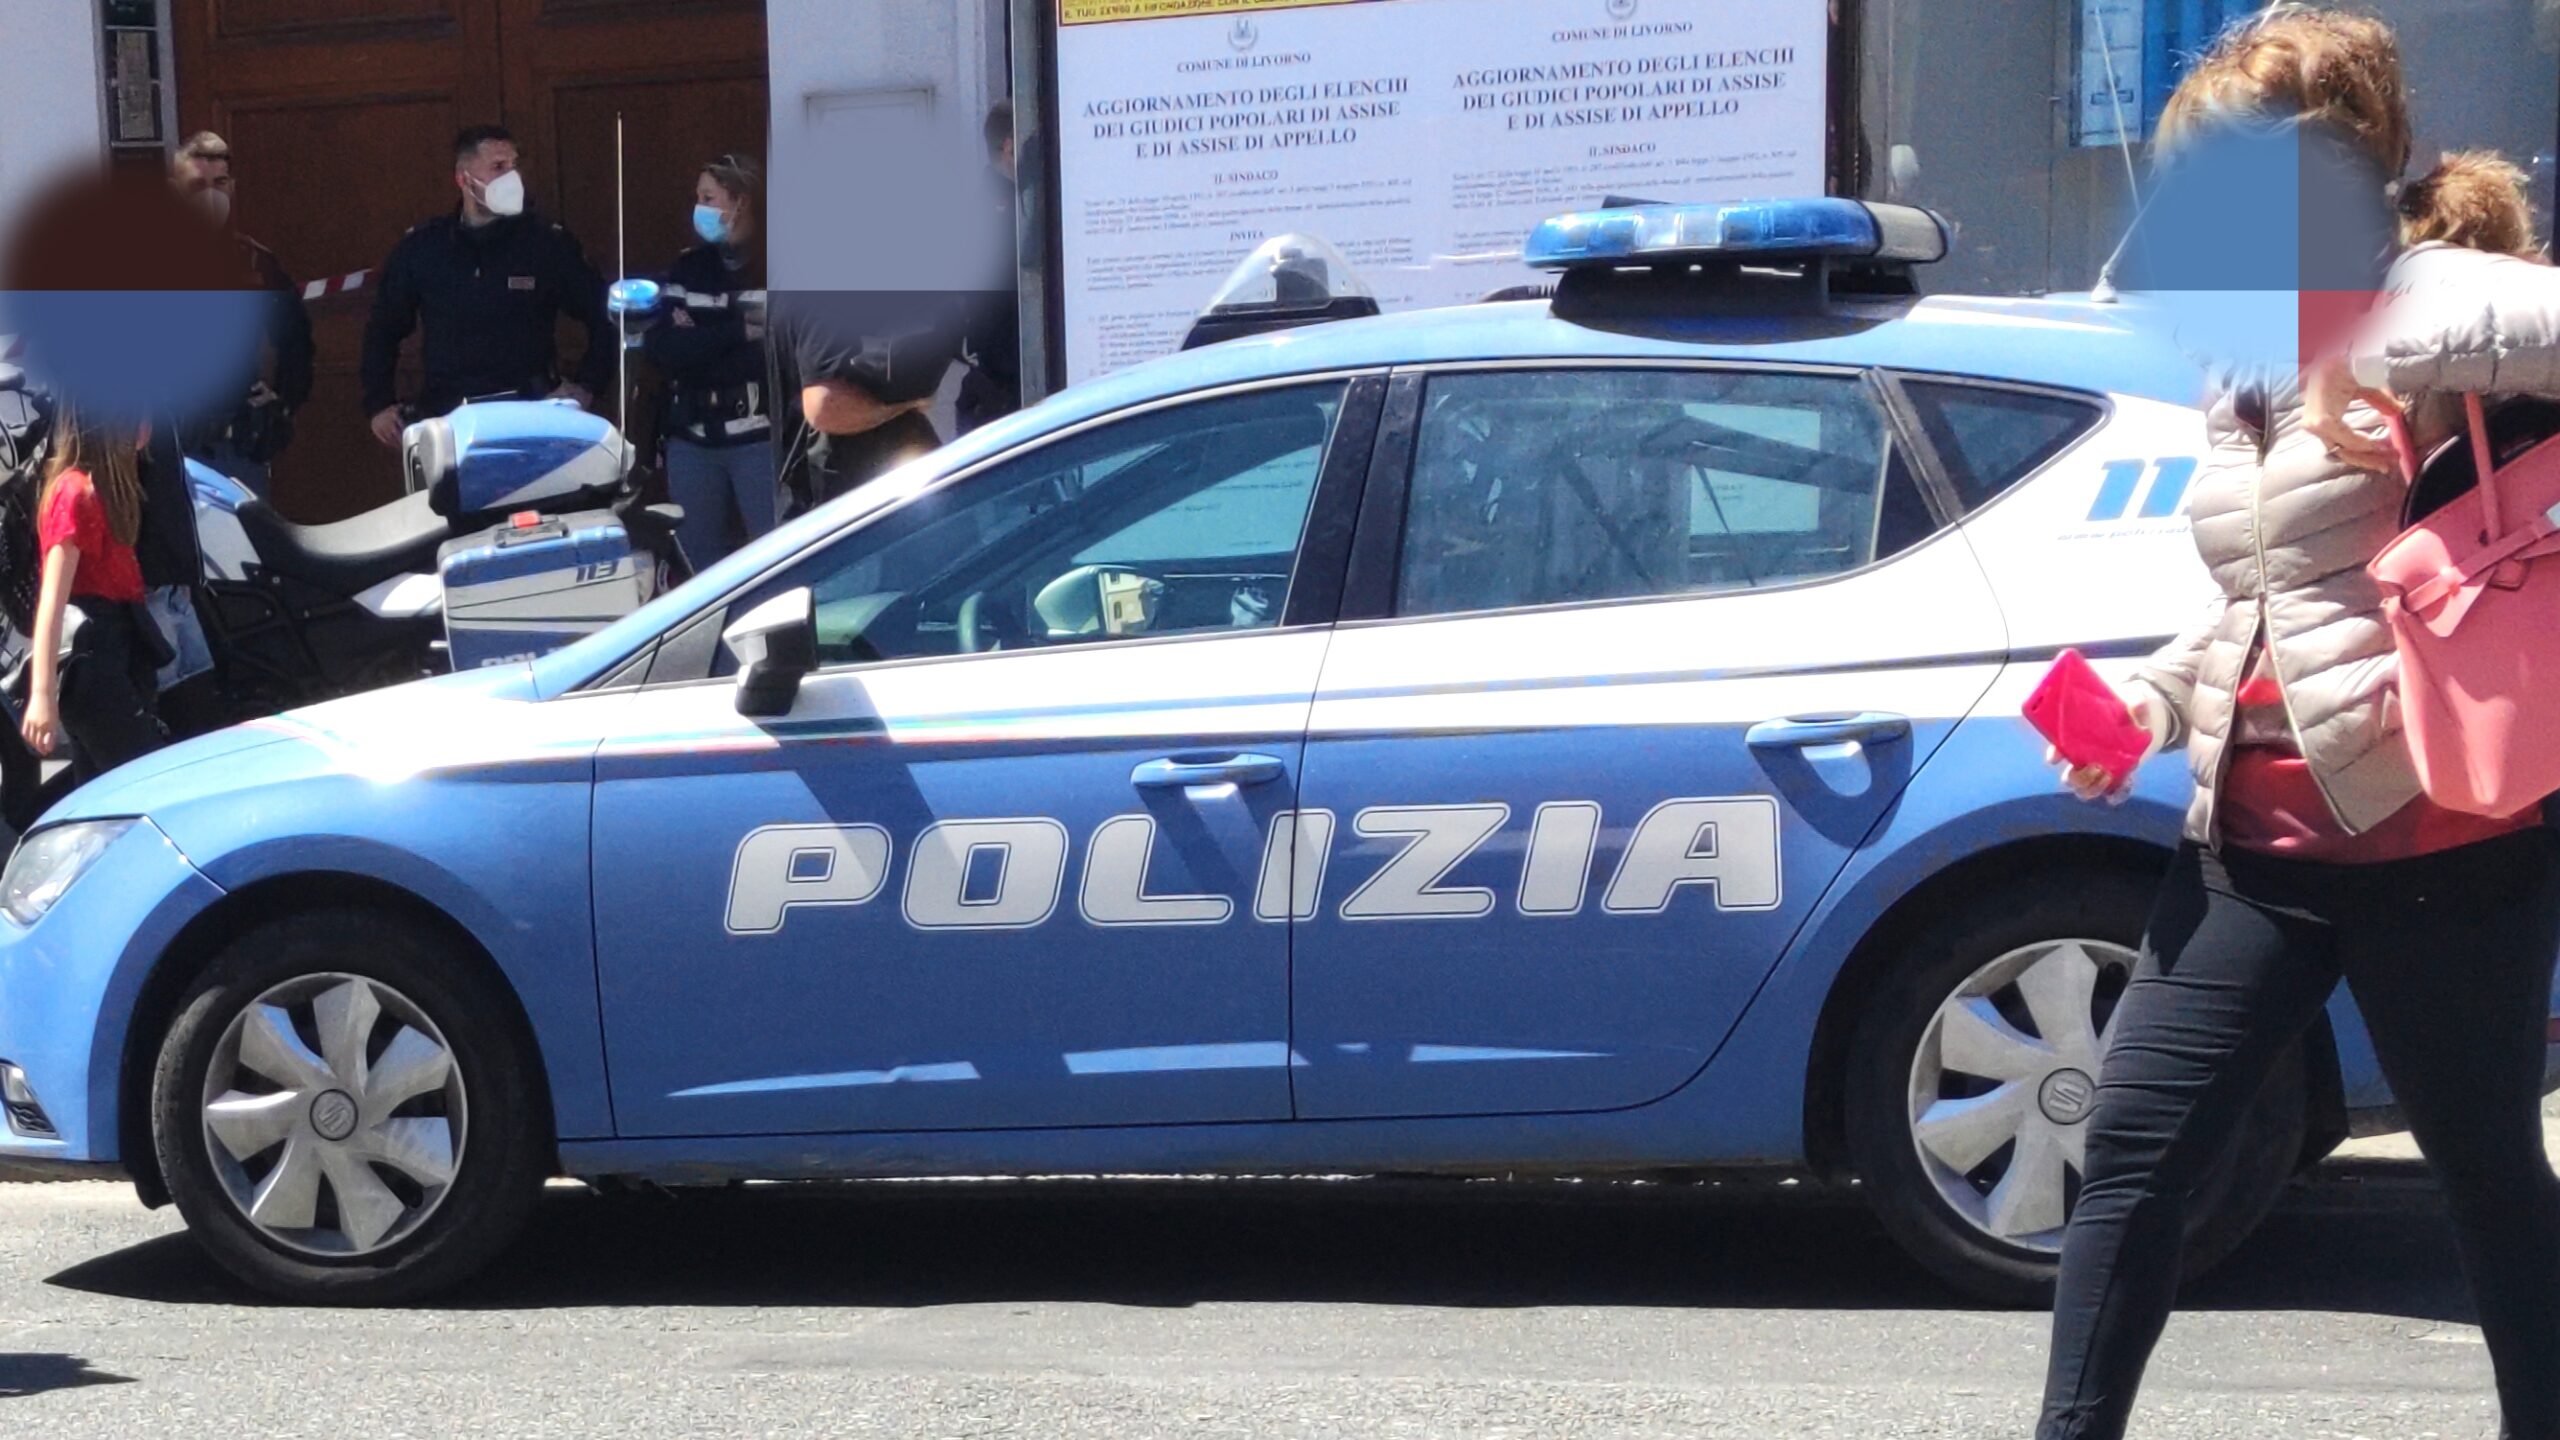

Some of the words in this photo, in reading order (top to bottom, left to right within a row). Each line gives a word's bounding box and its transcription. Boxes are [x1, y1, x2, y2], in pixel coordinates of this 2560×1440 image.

[1552, 27, 1610, 43] COMUNE
[1613, 25, 1628, 39] DI
[1630, 22, 1694, 38] LIVORNO
[1176, 58, 1232, 73] COMUNE
[1235, 56, 1249, 69] DI
[1252, 52, 1312, 68] LIVORNO
[1452, 59, 1631, 88] AGGIORNAMENTO
[1637, 53, 1698, 74] DEGLI
[1705, 47, 1795, 69] ELENCHI
[1083, 89, 1253, 118] AGGIORNAMENTO
[1259, 83, 1317, 103] DEGLI
[1323, 77, 1409, 99] ELENCHI
[1463, 92, 1495, 110] DEI
[1502, 86, 1578, 107] GIUDICI
[1585, 79, 1685, 101] POPOLARI
[1692, 77, 1711, 93] DI
[1717, 72, 1787, 92] ASSISE
[1093, 122, 1124, 139] DEI
[1130, 116, 1203, 136] GIUDICI
[1210, 109, 1305, 130] POPOLARI
[1311, 106, 1330, 123] DI
[1336, 101, 1401, 120] ASSISE
[1507, 115, 1519, 130] E
[1525, 112, 1545, 129] DI
[1551, 107, 1617, 127] ASSISE
[1621, 105, 1641, 121] DI
[1648, 99, 1739, 120] APPELLO
[1136, 143, 1147, 158] E
[1153, 140, 1172, 157] DI
[1178, 136, 1240, 155] ASSISE
[1245, 134, 1264, 150] DI
[1270, 127, 1357, 148] APPELLO
[1602, 142, 1657, 156] SINDACO
[1225, 169, 1279, 183] SINDACO
[2085, 456, 2198, 521] 11
[576, 560, 620, 583] 113
[723, 796, 1782, 934] POLIZIA
